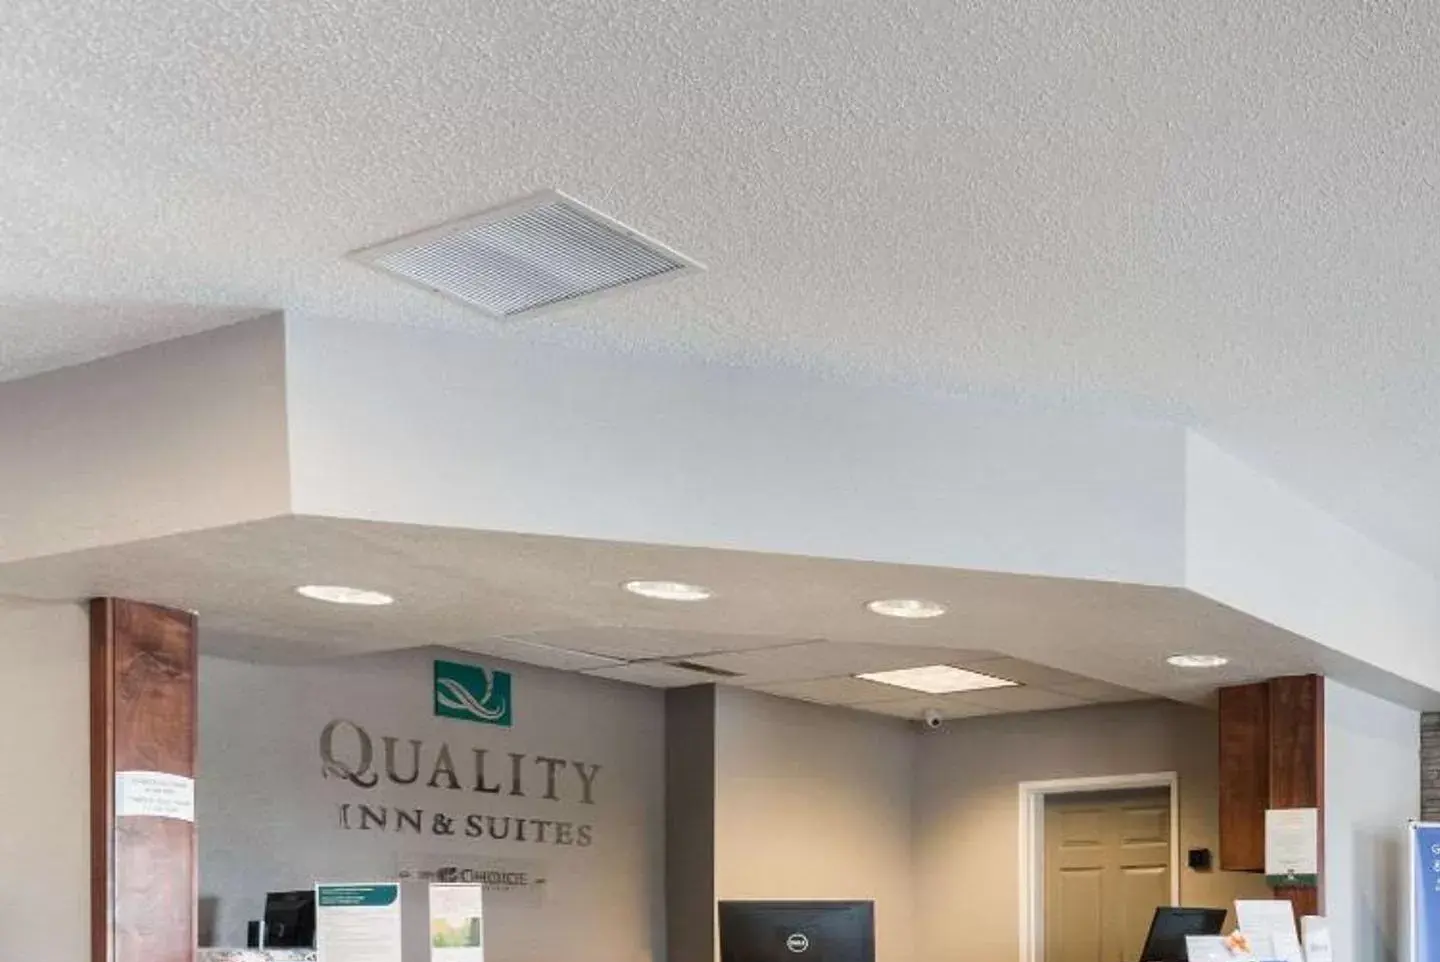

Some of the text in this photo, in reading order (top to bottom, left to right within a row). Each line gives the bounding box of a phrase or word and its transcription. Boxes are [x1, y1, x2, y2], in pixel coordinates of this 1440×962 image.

[319, 718, 604, 805] QUALITY
[339, 803, 594, 848] INN & SUITES
